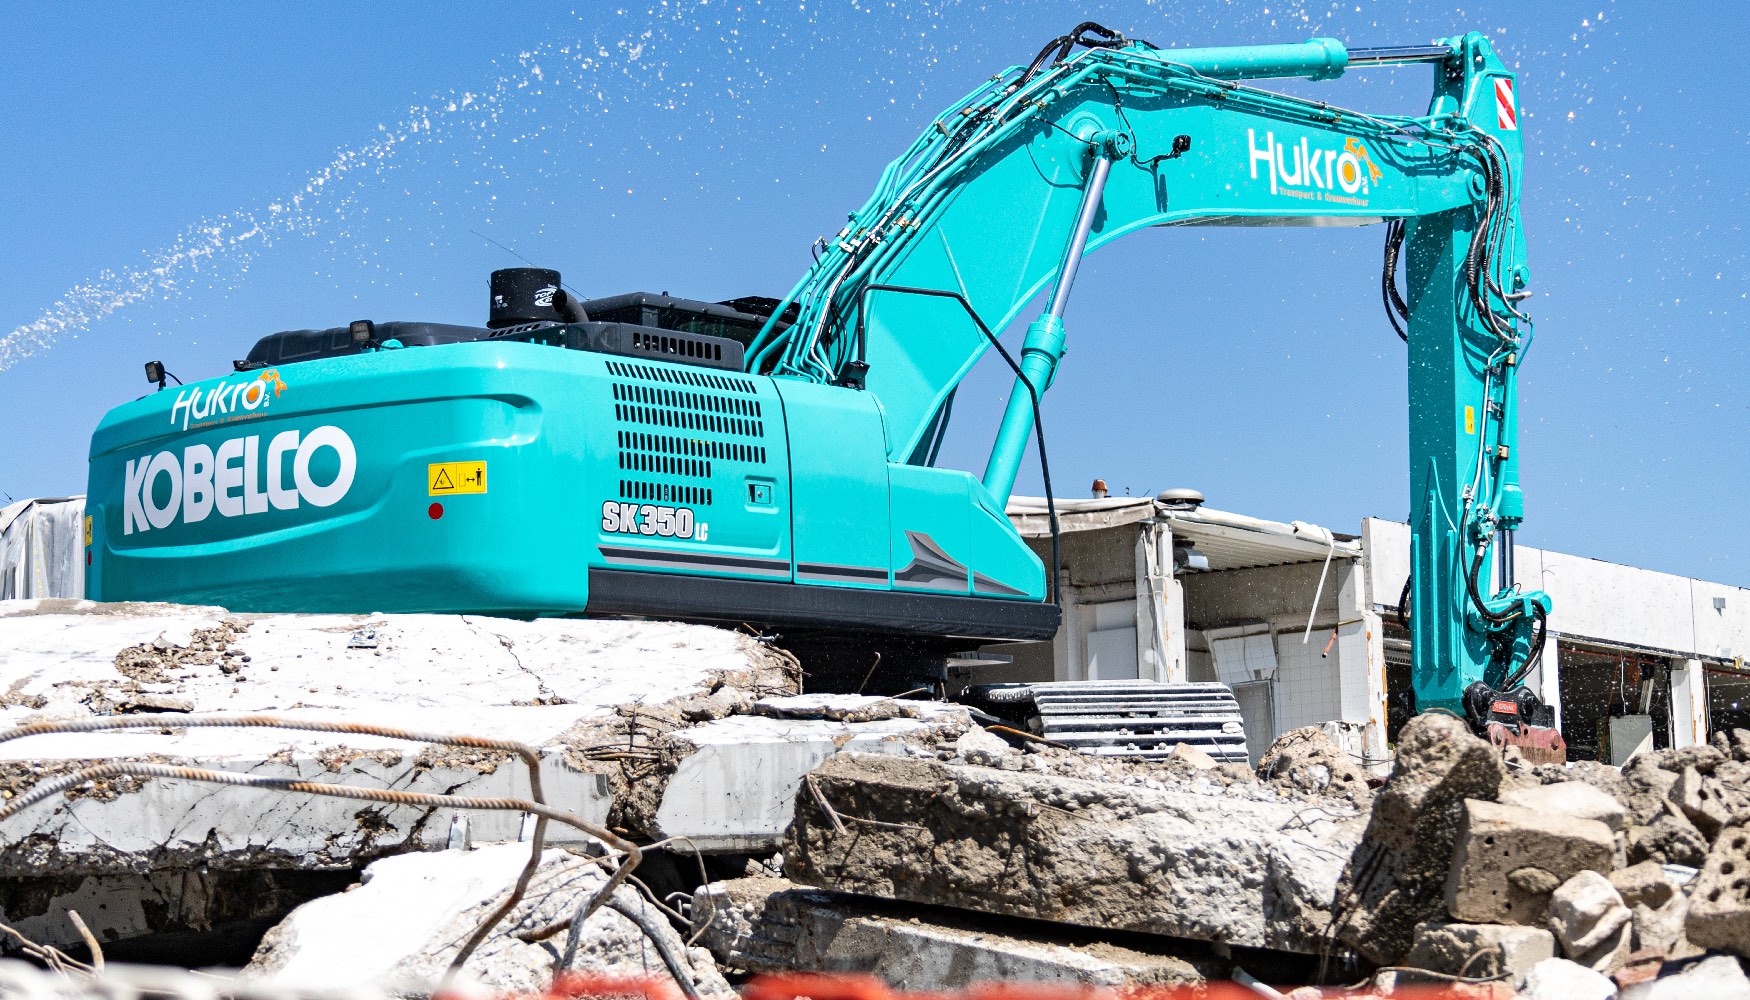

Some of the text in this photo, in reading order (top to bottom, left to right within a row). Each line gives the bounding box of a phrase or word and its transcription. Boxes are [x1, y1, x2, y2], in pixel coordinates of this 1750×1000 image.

[1248, 128, 1362, 195] Hukro
[1279, 186, 1314, 200] Transport
[1317, 191, 1323, 200] &
[170, 378, 267, 431] Hukro
[263, 392, 271, 407] B.V.
[123, 425, 357, 536] KOBELCO
[601, 500, 708, 542] SK350 LC
